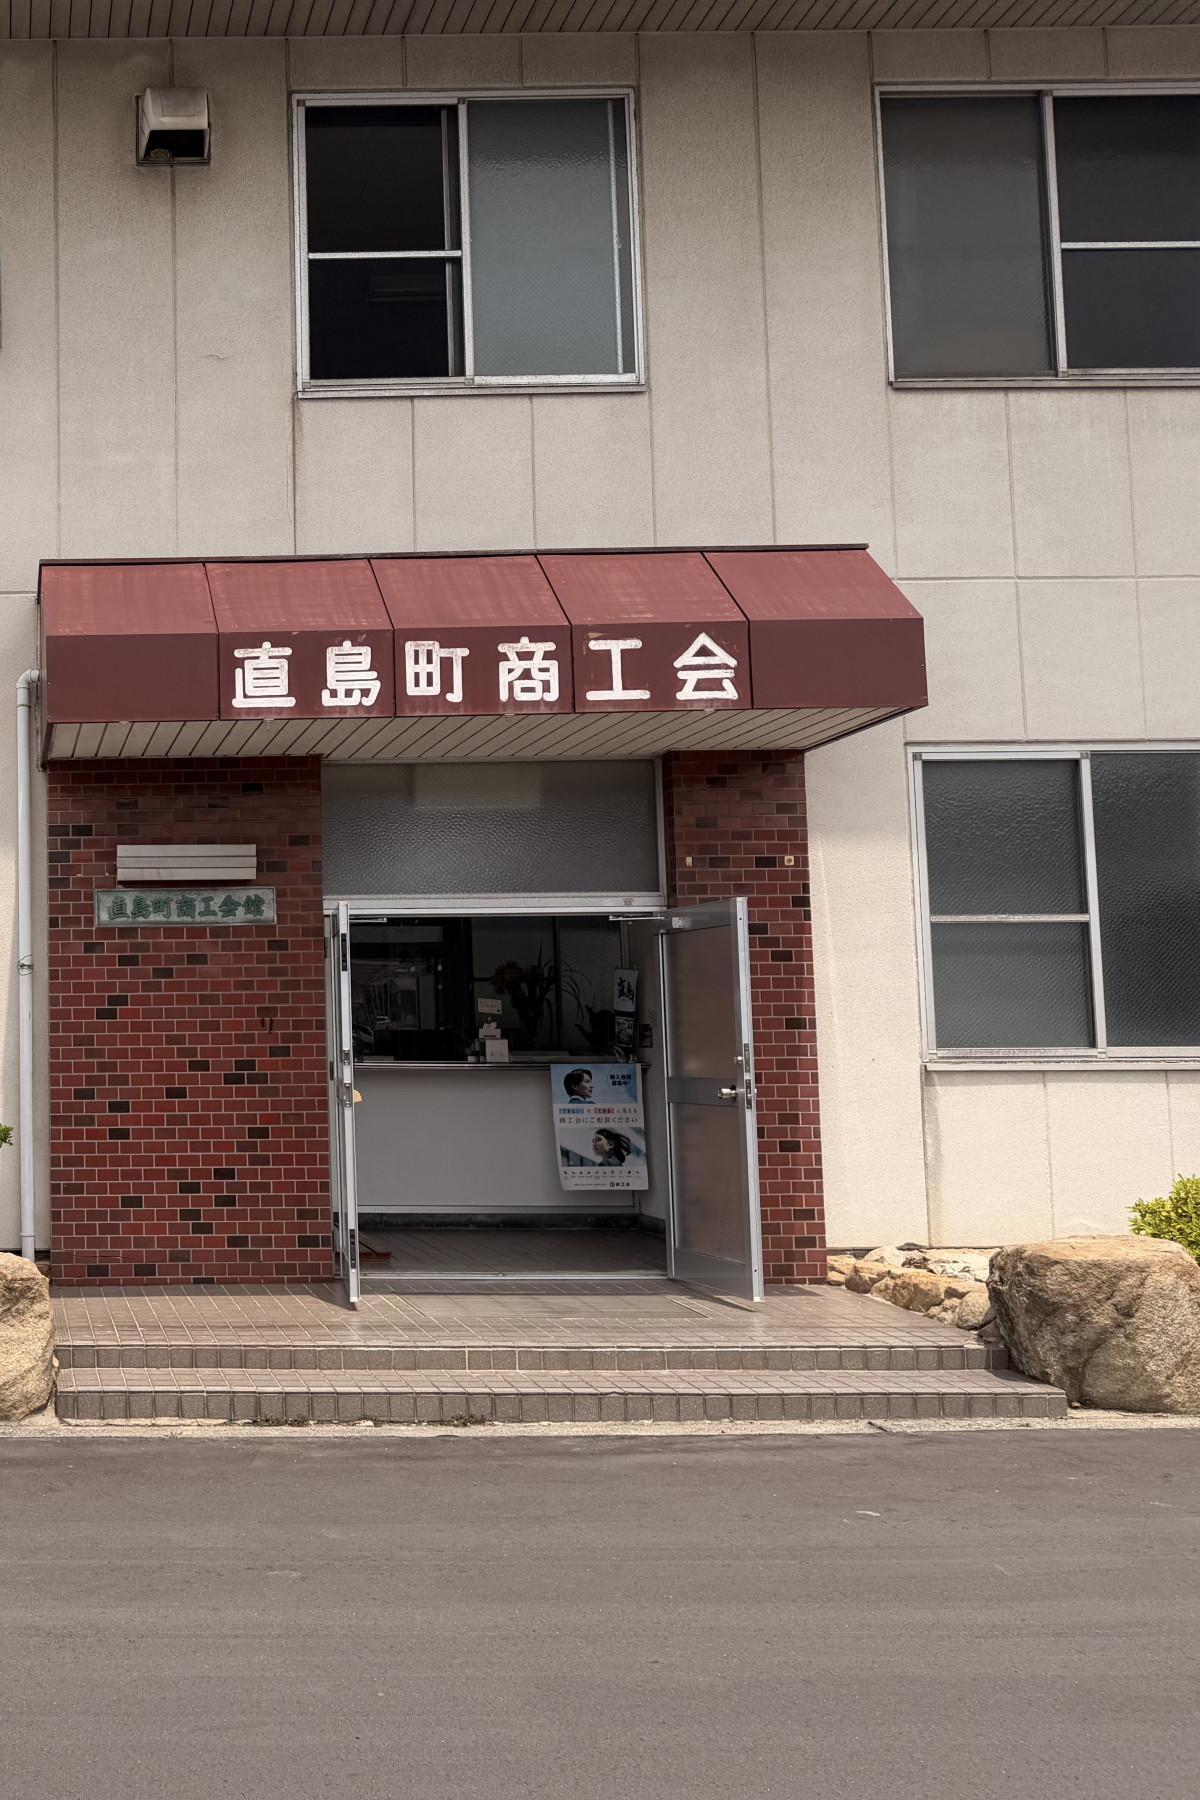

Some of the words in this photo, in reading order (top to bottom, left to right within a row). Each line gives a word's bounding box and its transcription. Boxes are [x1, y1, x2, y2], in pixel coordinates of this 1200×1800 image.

[231, 632, 738, 708] 直島町商工会
[108, 894, 266, 920] 直島町商工会館
